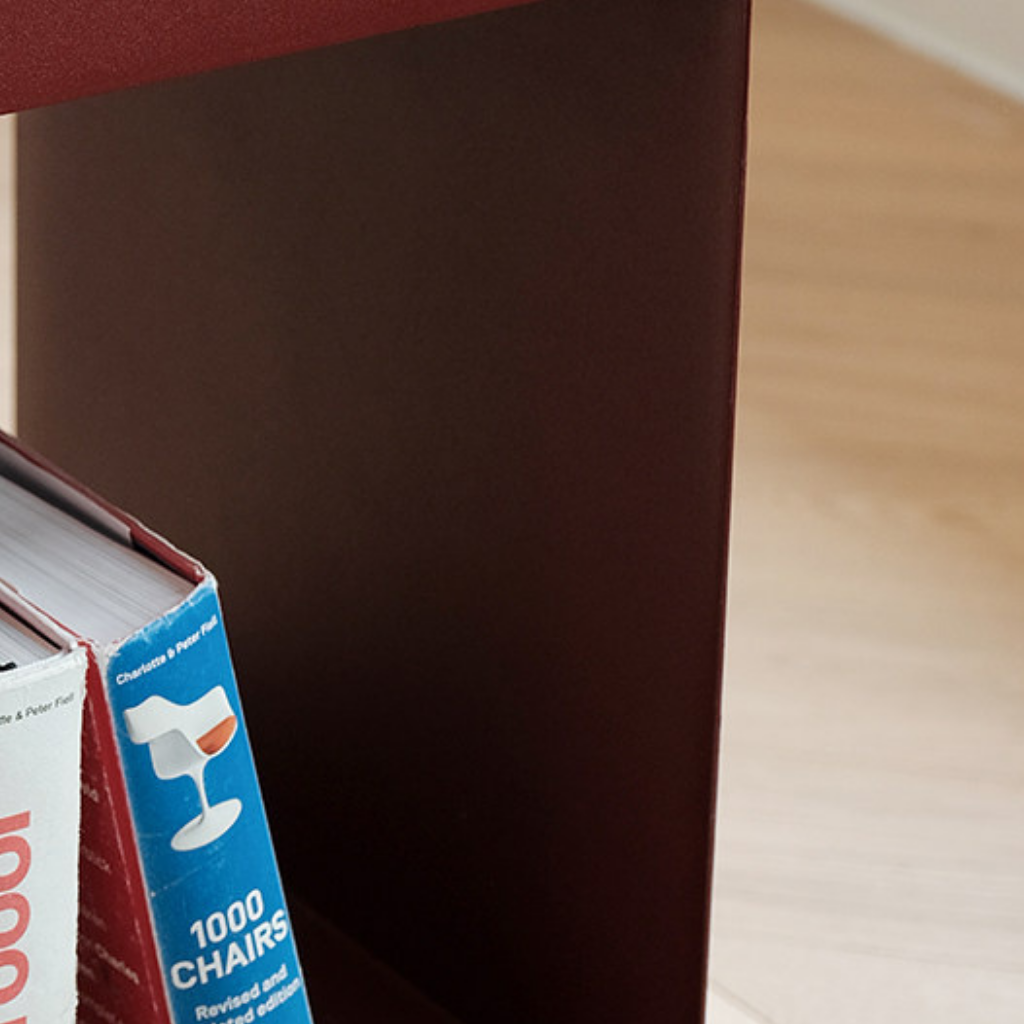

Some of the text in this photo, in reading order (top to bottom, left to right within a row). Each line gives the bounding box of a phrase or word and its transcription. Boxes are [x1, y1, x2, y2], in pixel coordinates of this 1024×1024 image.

[116, 654, 167, 685] Charlotte
[175, 631, 201, 654] Peter
[15, 710, 24, 722] &
[25, 701, 54, 718] Peter
[189, 888, 265, 950] 1000
[170, 907, 288, 991] CHAIRS
[194, 962, 289, 1022] Revised and
[256, 976, 302, 1018] edition
